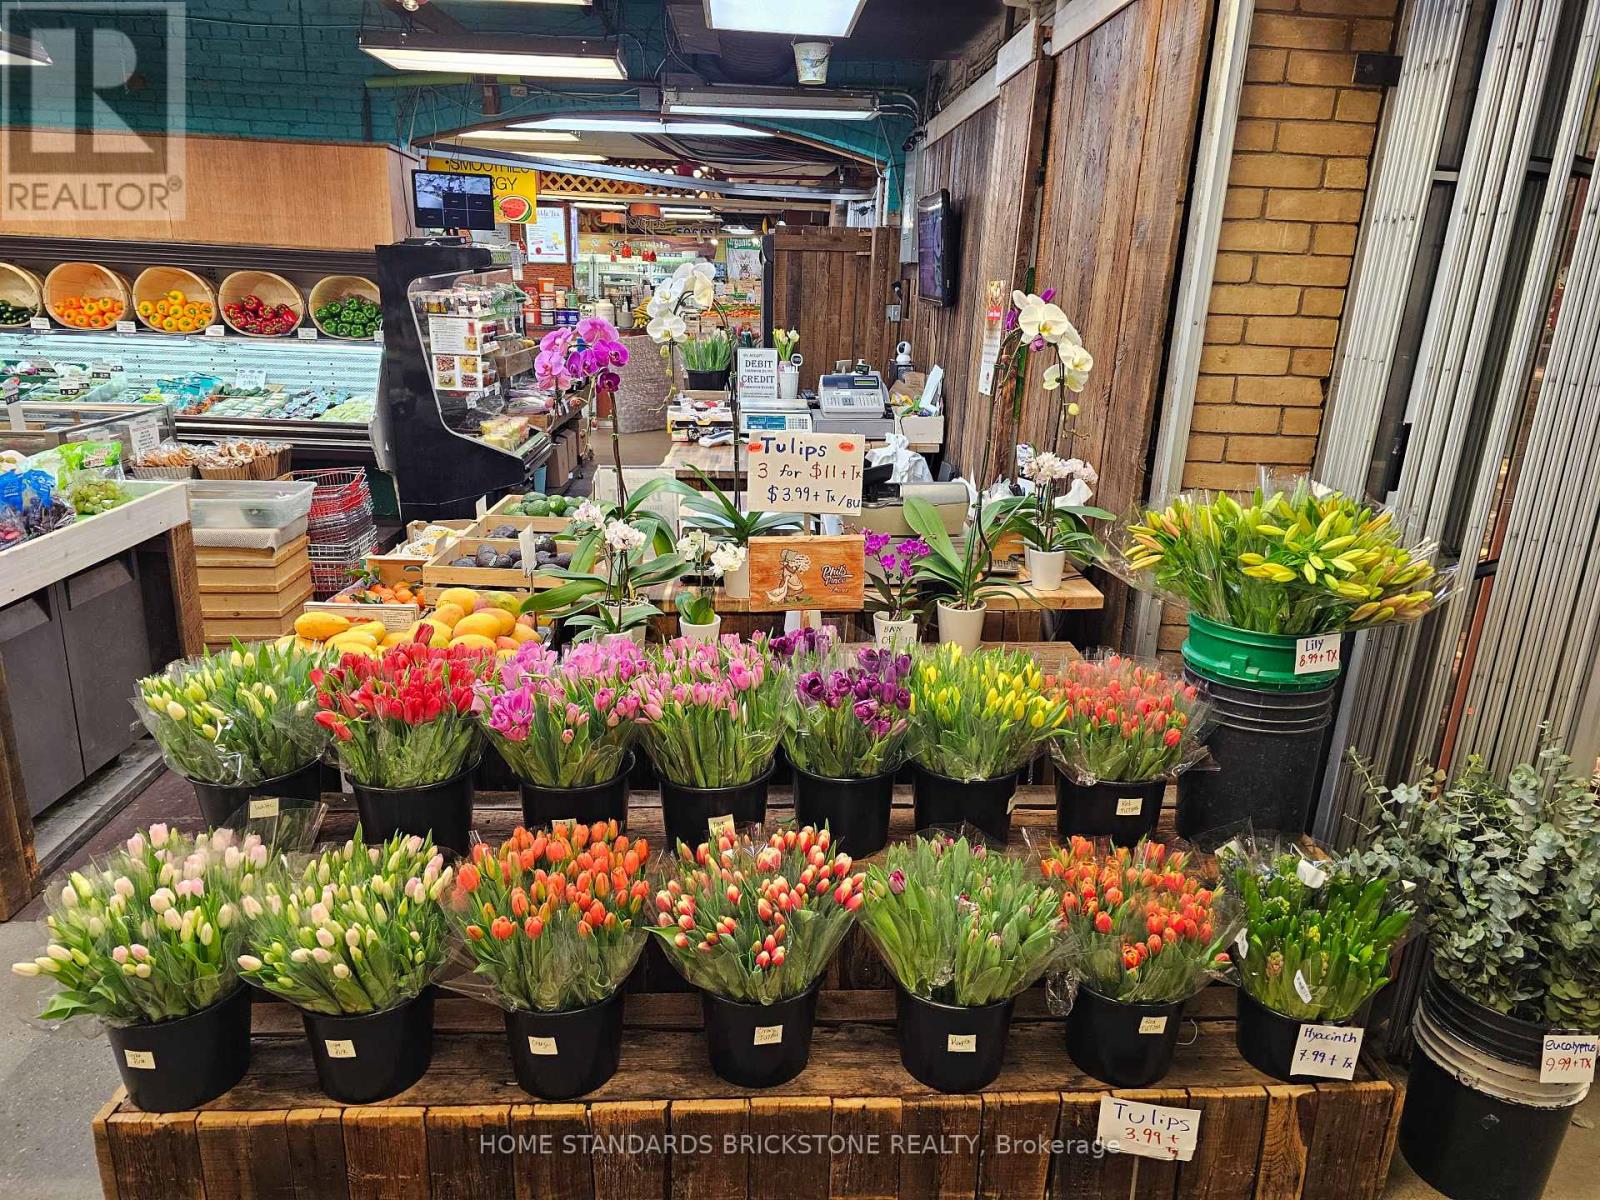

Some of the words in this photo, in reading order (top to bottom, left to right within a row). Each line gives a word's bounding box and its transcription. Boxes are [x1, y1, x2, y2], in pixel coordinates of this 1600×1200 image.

[745, 359, 774, 369] DEBIT
[741, 374, 776, 384] CREDIT
[760, 436, 828, 462] Tulips
[757, 462, 769, 479] 3
[779, 464, 802, 479] for
[1305, 639, 1325, 652] Lily
[1304, 1027, 1357, 1044] Hyacinth
[1113, 1102, 1191, 1132] Tulips
[1124, 1127, 1161, 1145] 3.99
